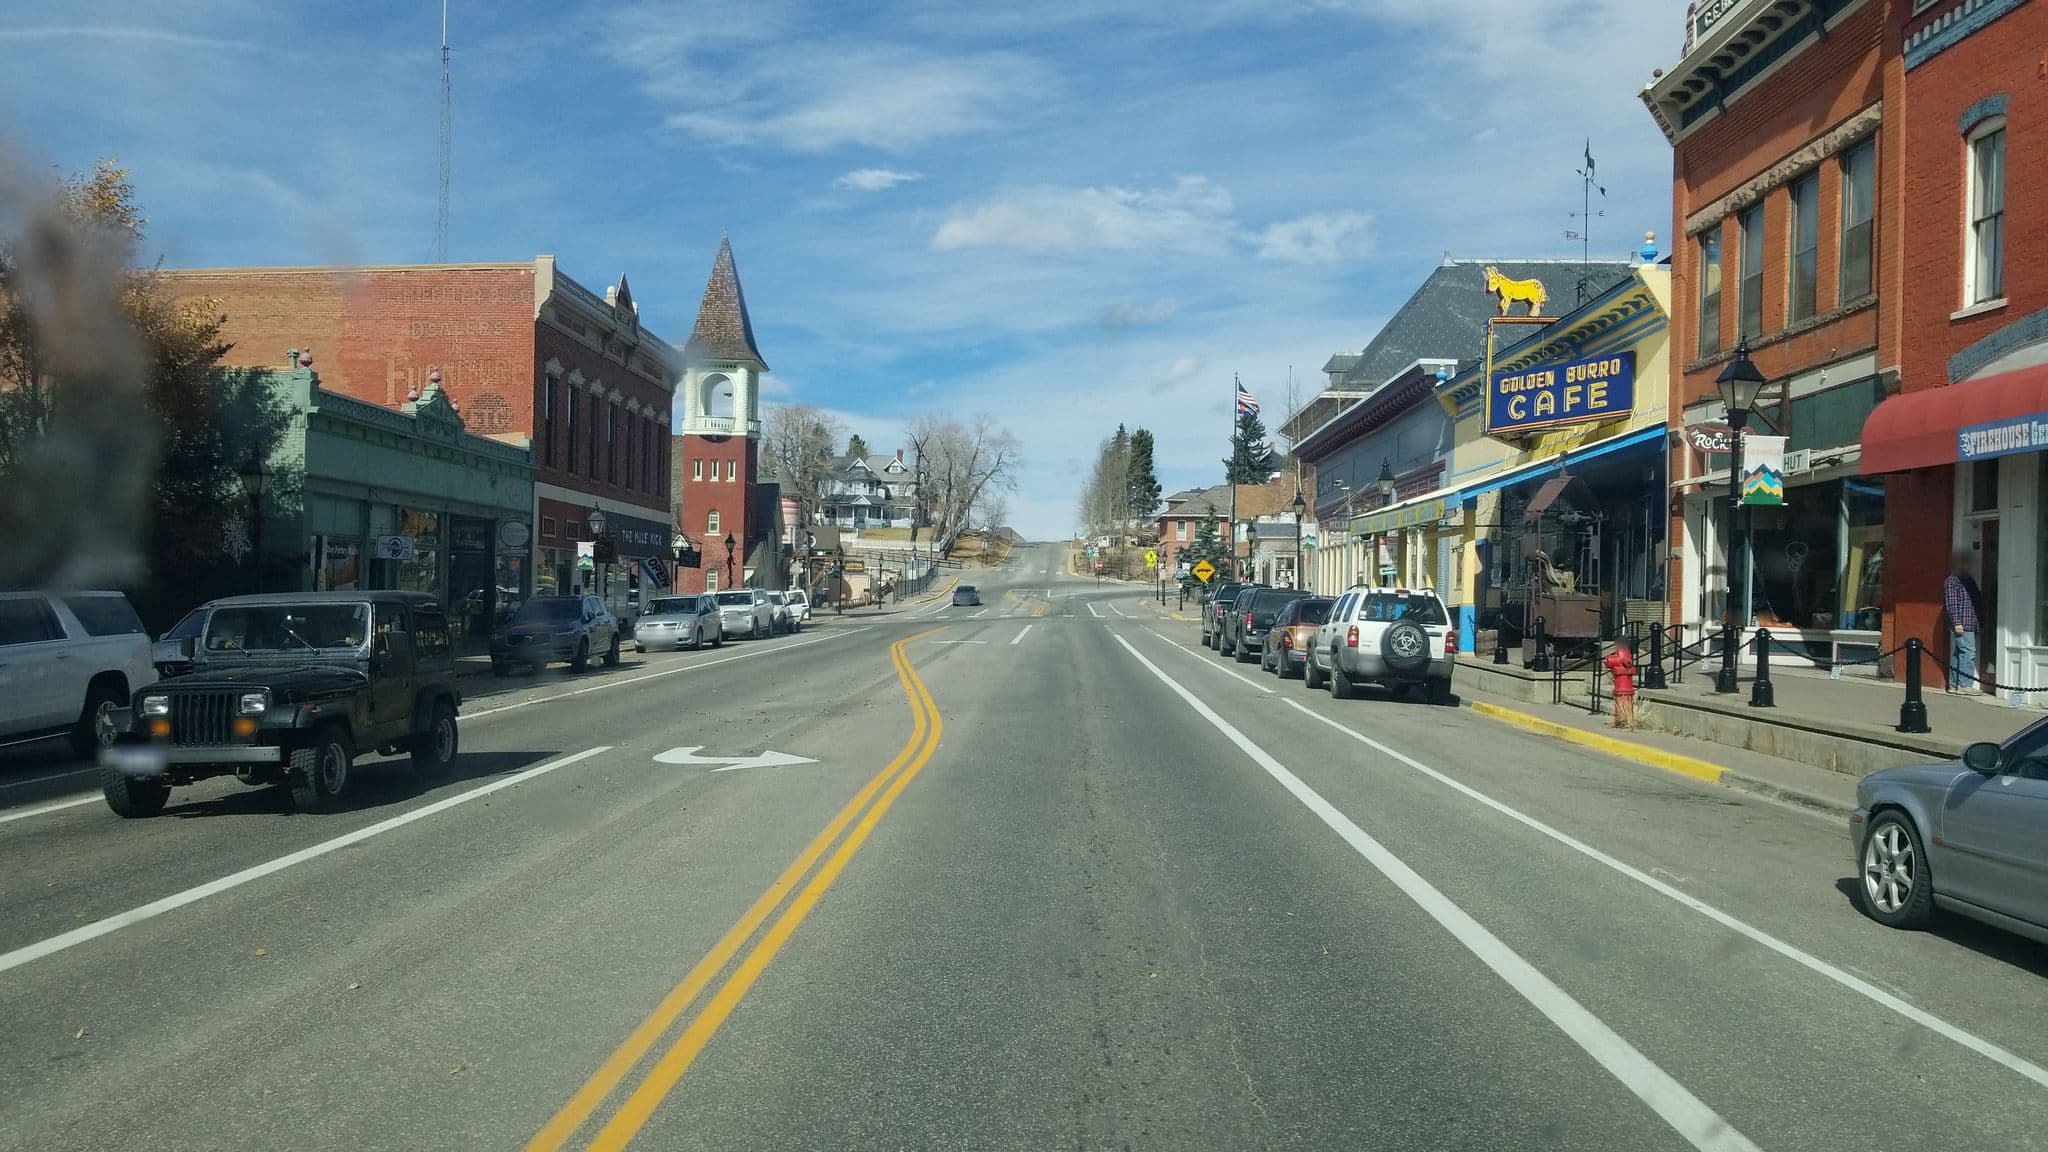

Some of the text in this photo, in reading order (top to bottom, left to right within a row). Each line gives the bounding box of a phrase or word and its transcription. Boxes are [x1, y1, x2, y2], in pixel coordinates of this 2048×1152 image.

[1500, 358, 1621, 394] GOLDEN BURRO
[1507, 381, 1609, 421] CAFE
[1967, 422, 2030, 456] FIREHOUSE
[1783, 453, 1802, 472] HUT
[621, 529, 633, 544] THE
[634, 530, 648, 545] MULE
[647, 558, 671, 588] OPEN
